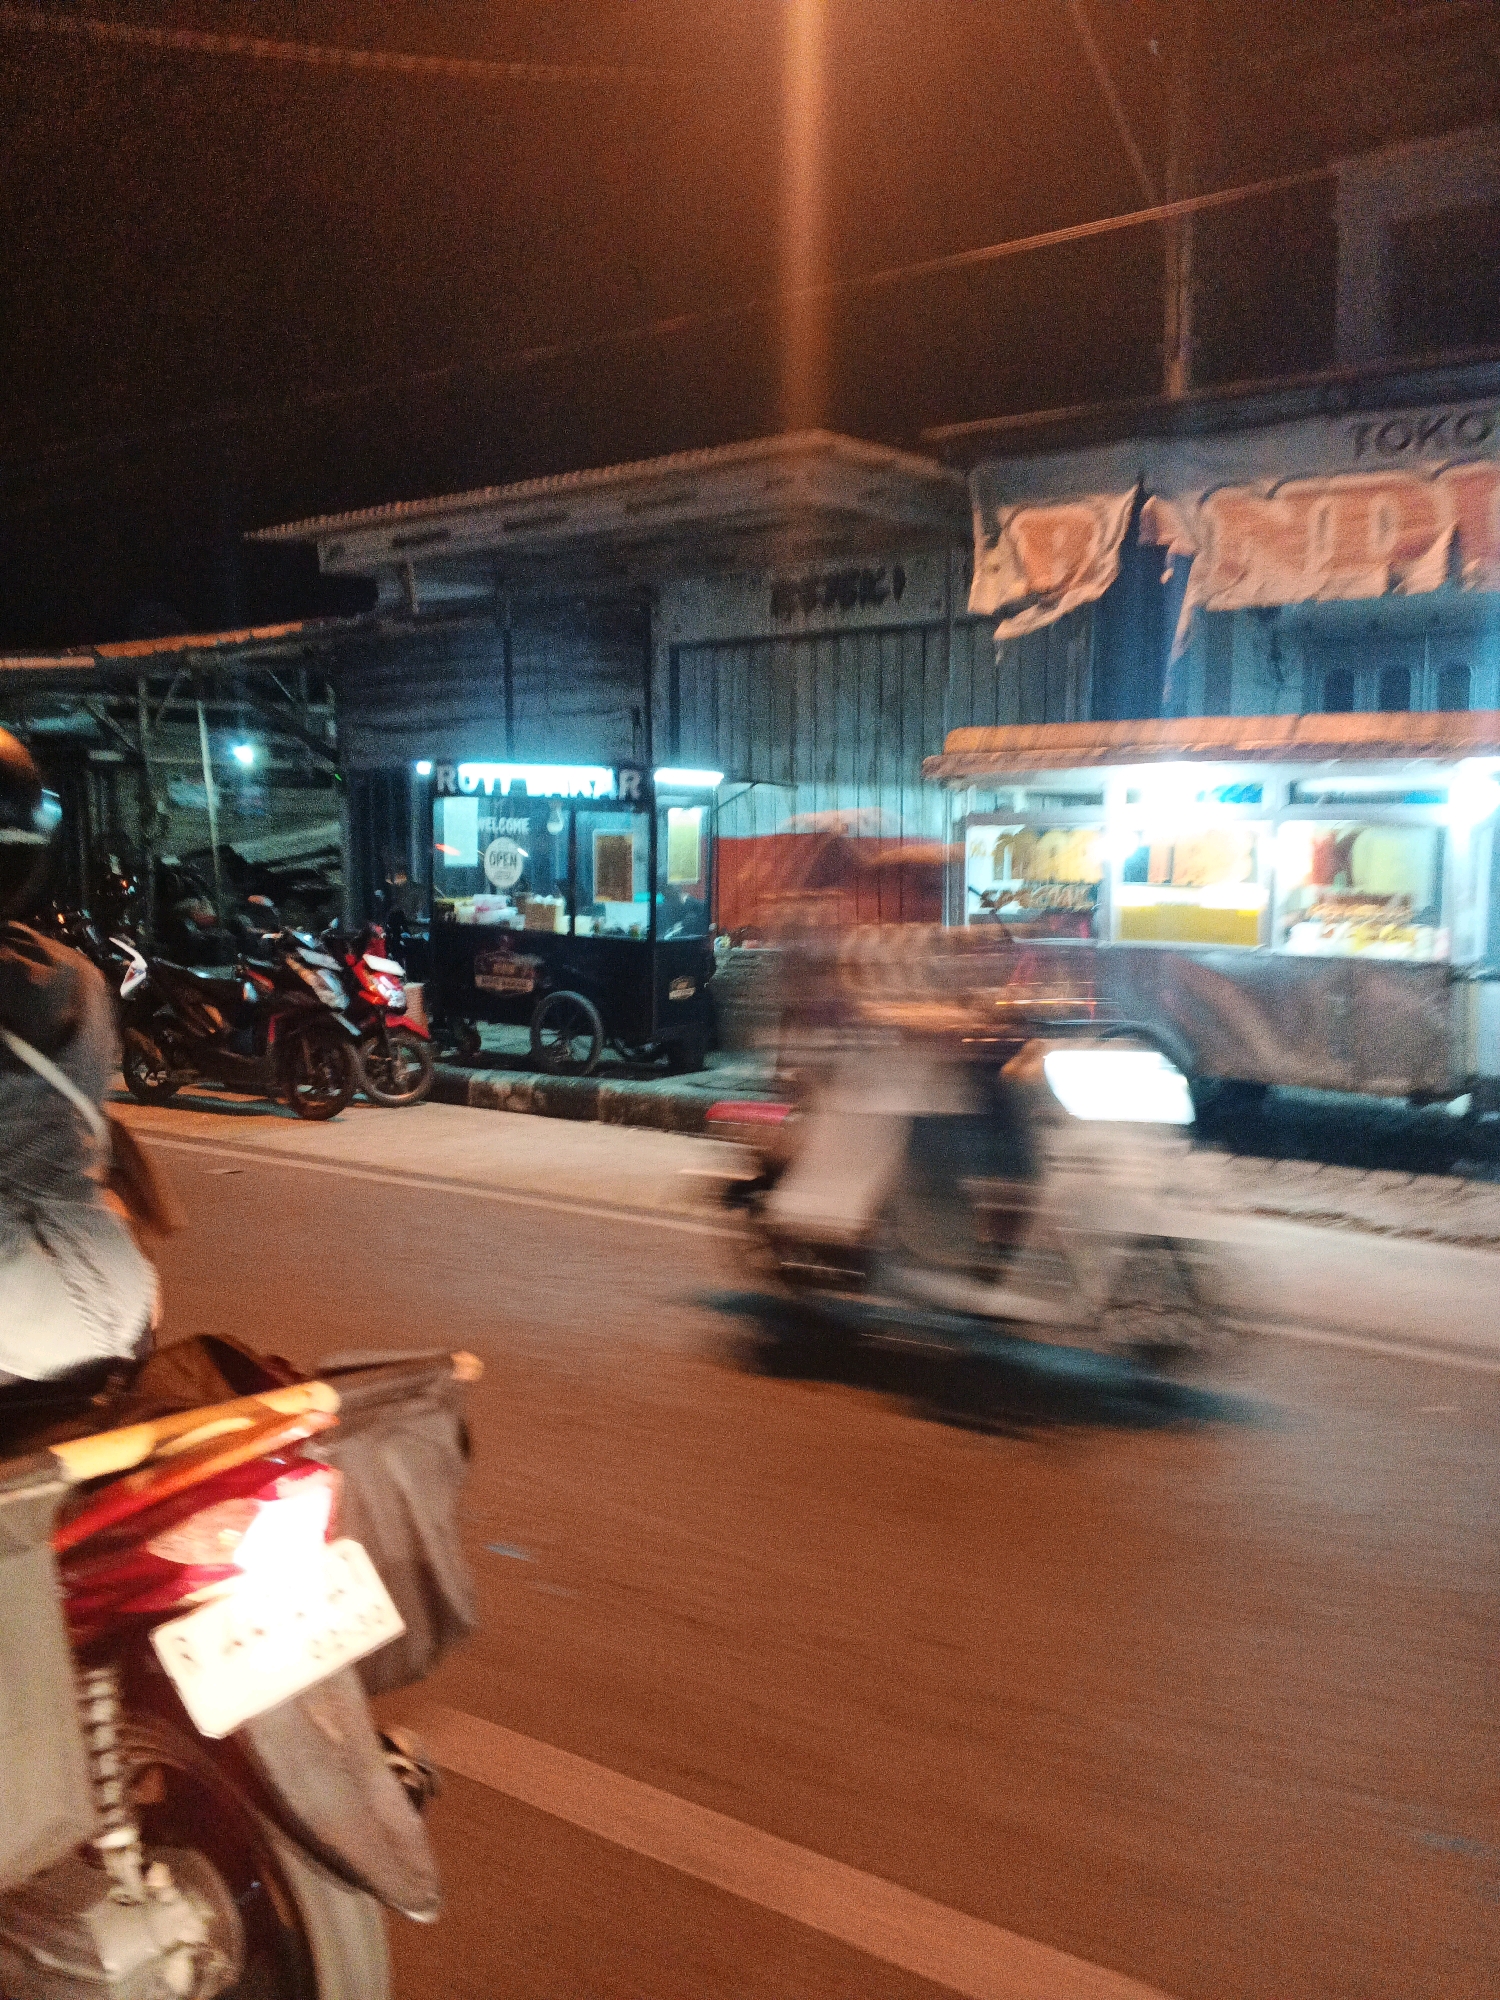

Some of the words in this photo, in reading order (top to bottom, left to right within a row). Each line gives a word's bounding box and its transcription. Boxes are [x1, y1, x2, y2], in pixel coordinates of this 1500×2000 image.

[1350, 410, 1494, 462] TOKO
[436, 763, 511, 797] ROTI
[477, 815, 530, 835] WELCOME
[489, 851, 518, 868] OPEN
